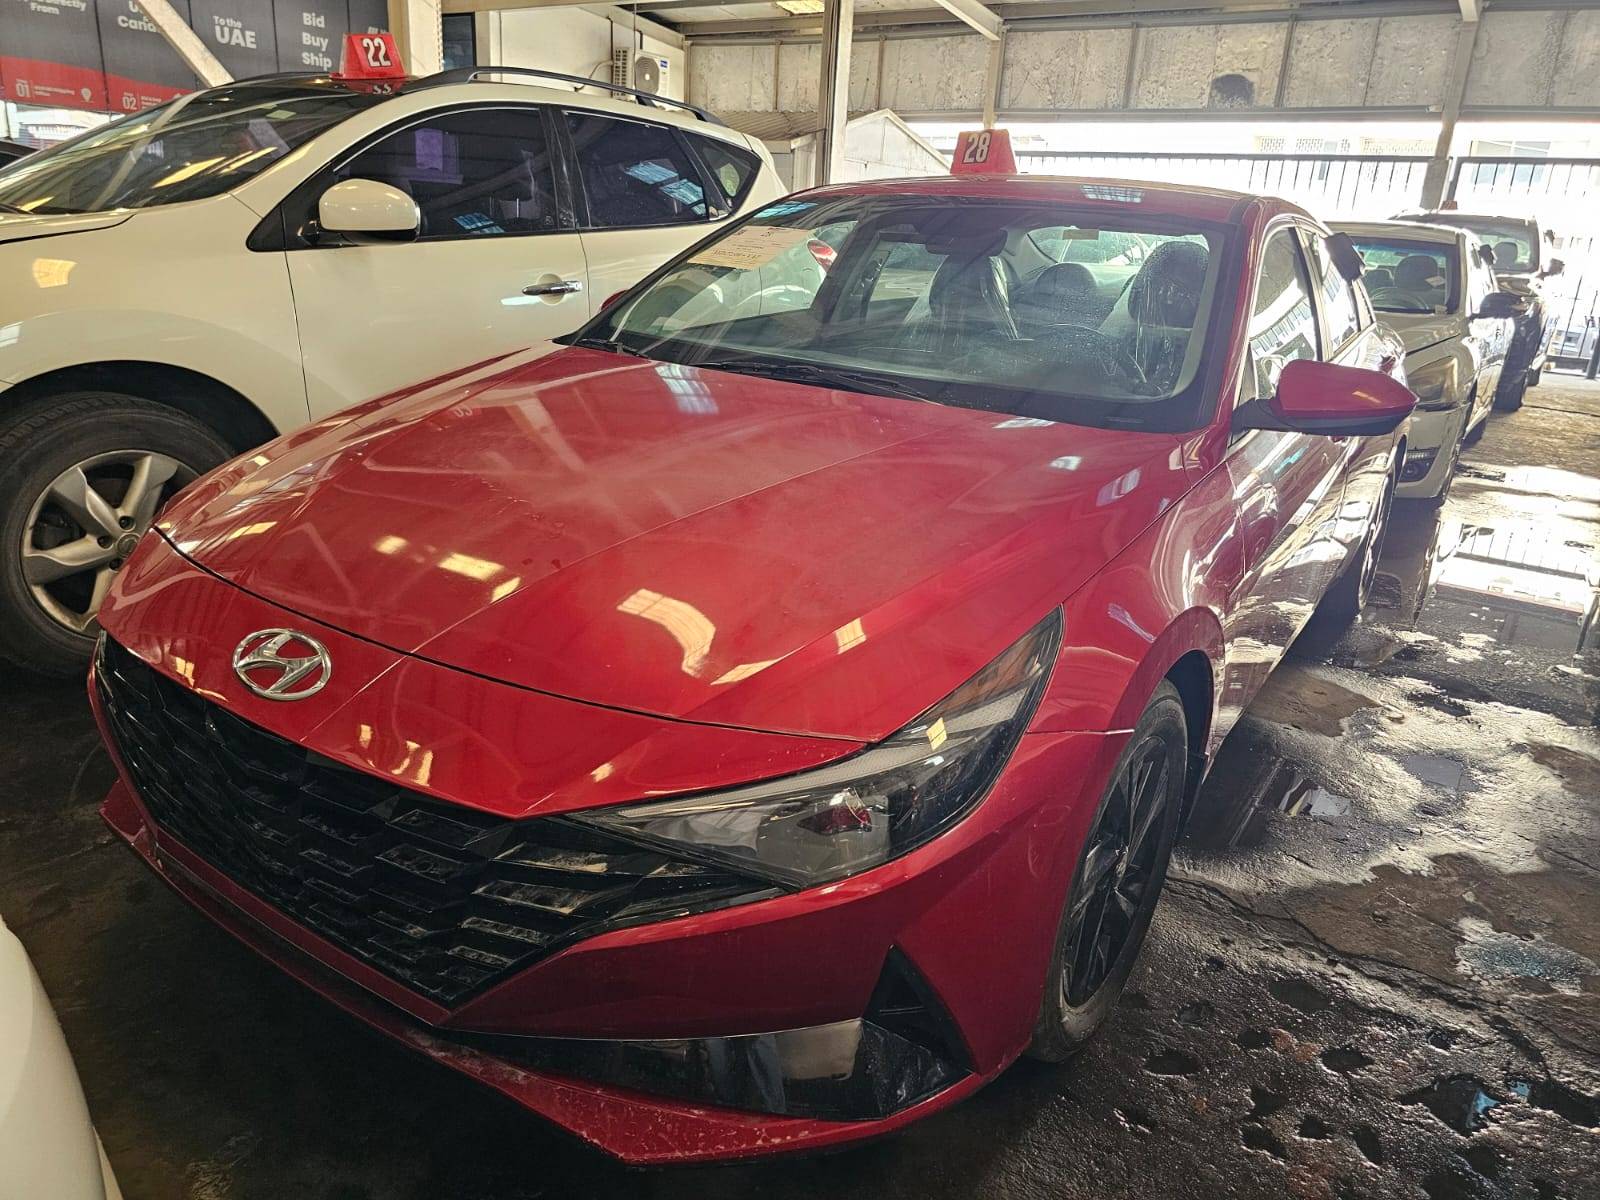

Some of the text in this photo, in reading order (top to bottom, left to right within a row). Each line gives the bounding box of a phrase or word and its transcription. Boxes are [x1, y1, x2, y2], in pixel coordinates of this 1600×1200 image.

[30, 2, 60, 15] From
[212, 15, 242, 29] To the
[302, 12, 326, 28] Bid
[214, 24, 257, 49] UAE
[302, 31, 329, 52] Buy
[361, 37, 392, 67] 22
[301, 51, 332, 72] Ship
[16, 82, 31, 97] 01
[122, 96, 137, 110] 02
[962, 131, 992, 164] 28
